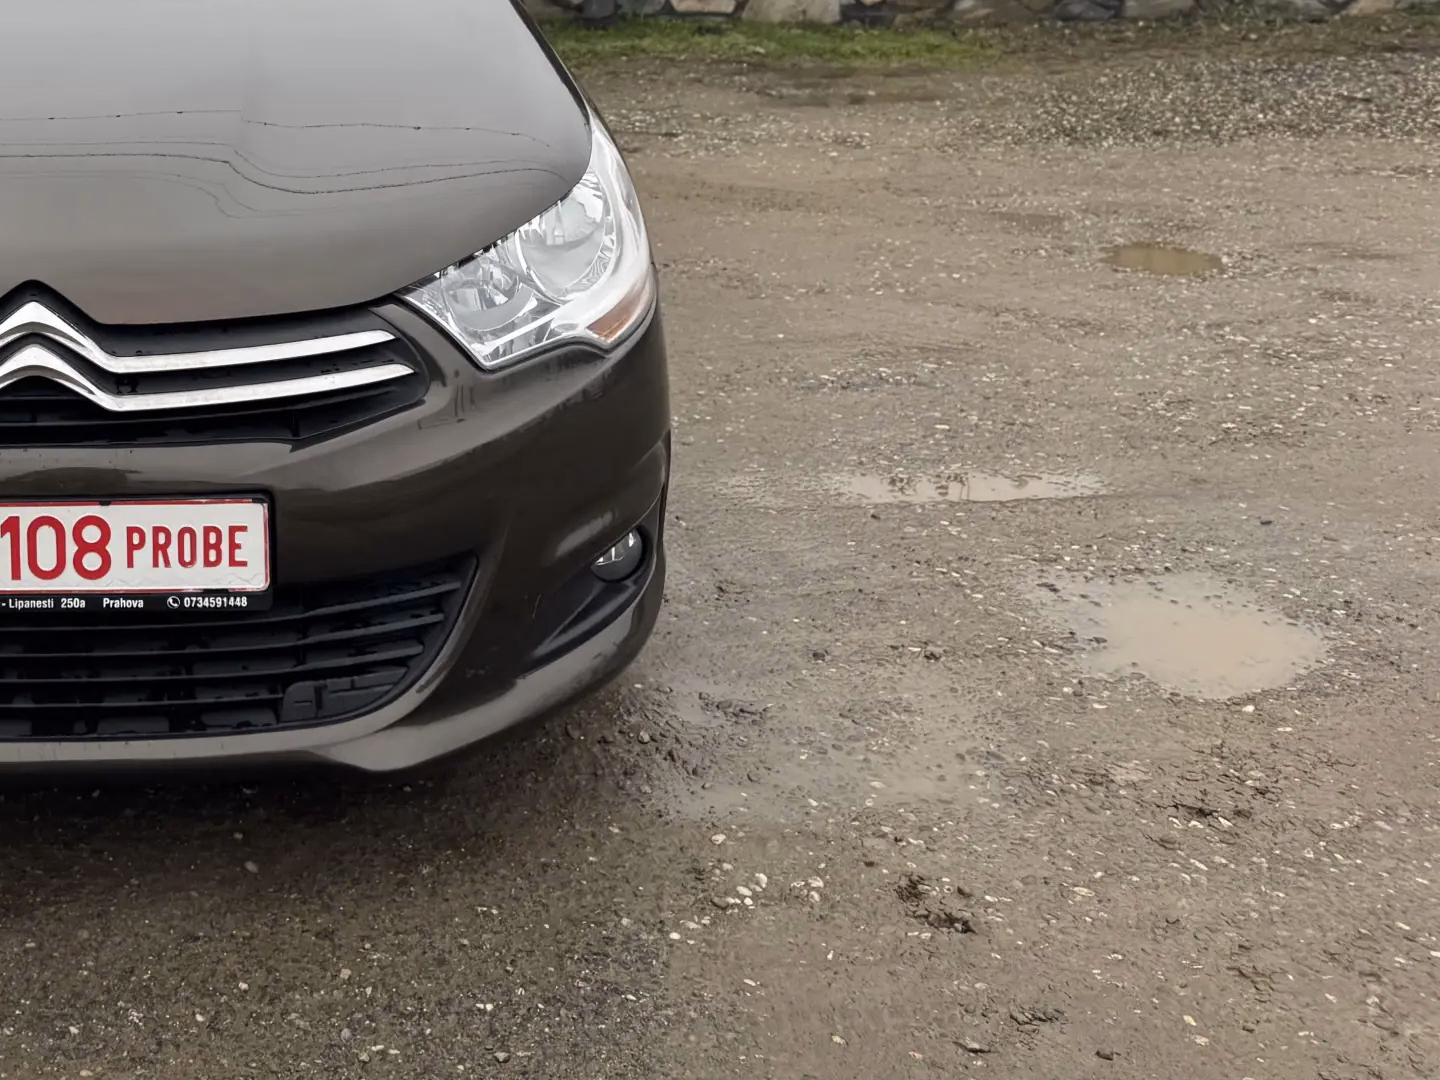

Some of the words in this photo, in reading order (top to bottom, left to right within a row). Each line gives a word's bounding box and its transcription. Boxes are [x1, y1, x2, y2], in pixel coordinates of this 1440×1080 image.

[0, 514, 112, 582] 108
[125, 524, 249, 568] PROBE
[8, 597, 55, 610] Lipanesti
[60, 597, 86, 609] 250a
[102, 597, 144, 610] Prahova
[183, 596, 248, 609] 0734591448
